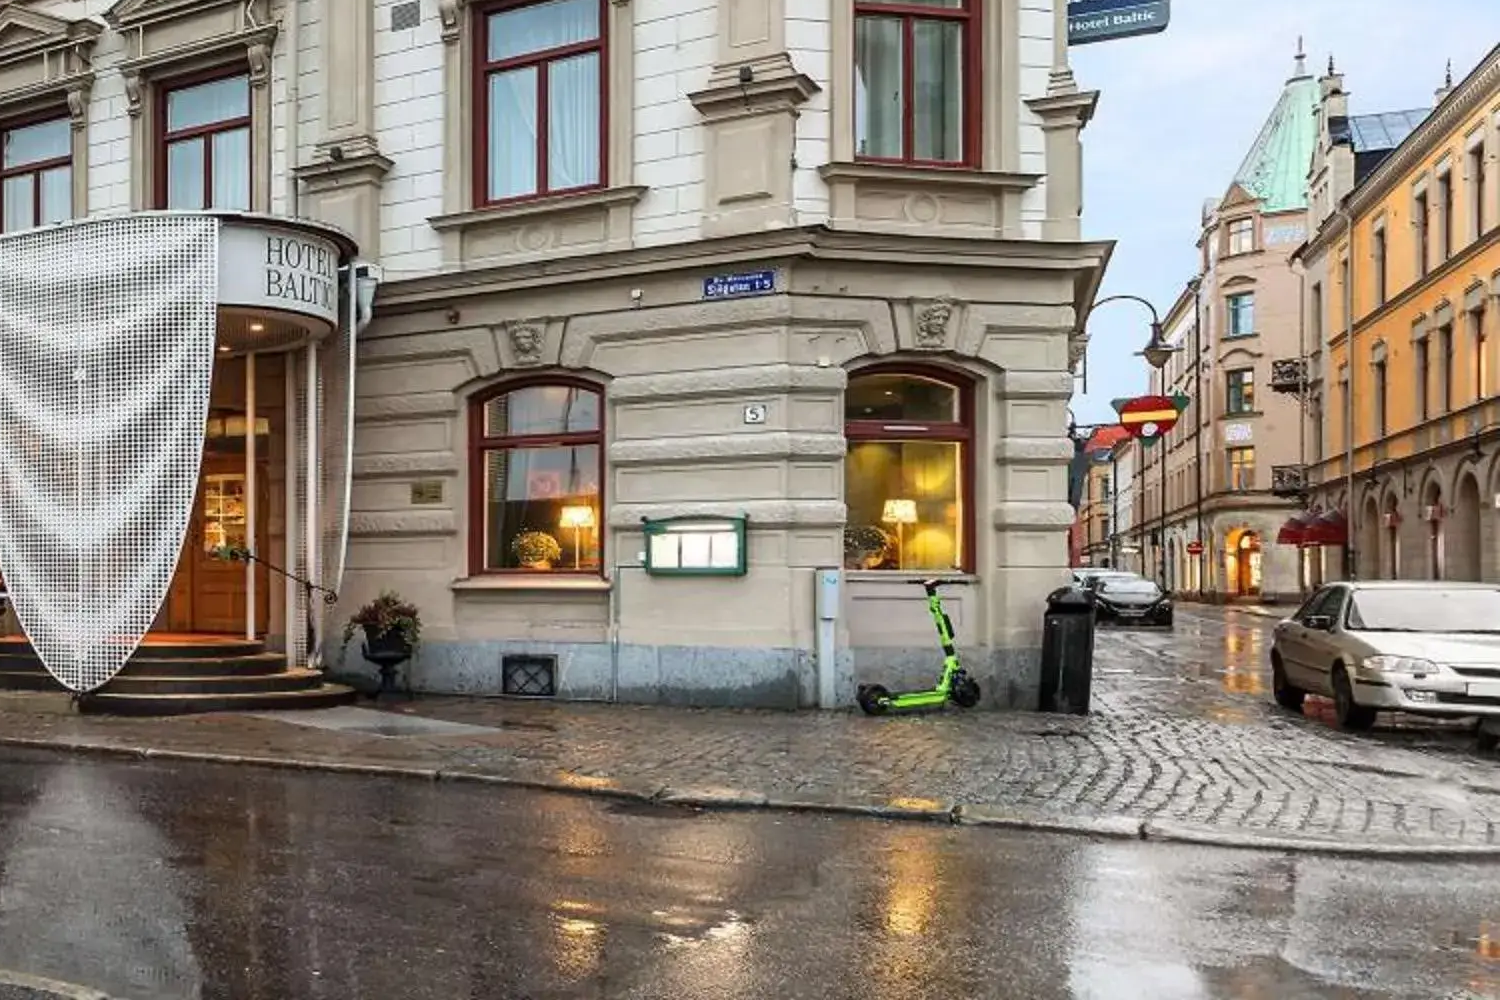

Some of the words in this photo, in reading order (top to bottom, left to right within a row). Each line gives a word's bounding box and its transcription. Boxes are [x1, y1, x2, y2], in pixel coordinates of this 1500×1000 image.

[1069, 16, 1109, 33] Hotel
[1113, 10, 1157, 26] Baltic
[265, 237, 333, 278] HOTEL
[748, 407, 760, 421] 5
